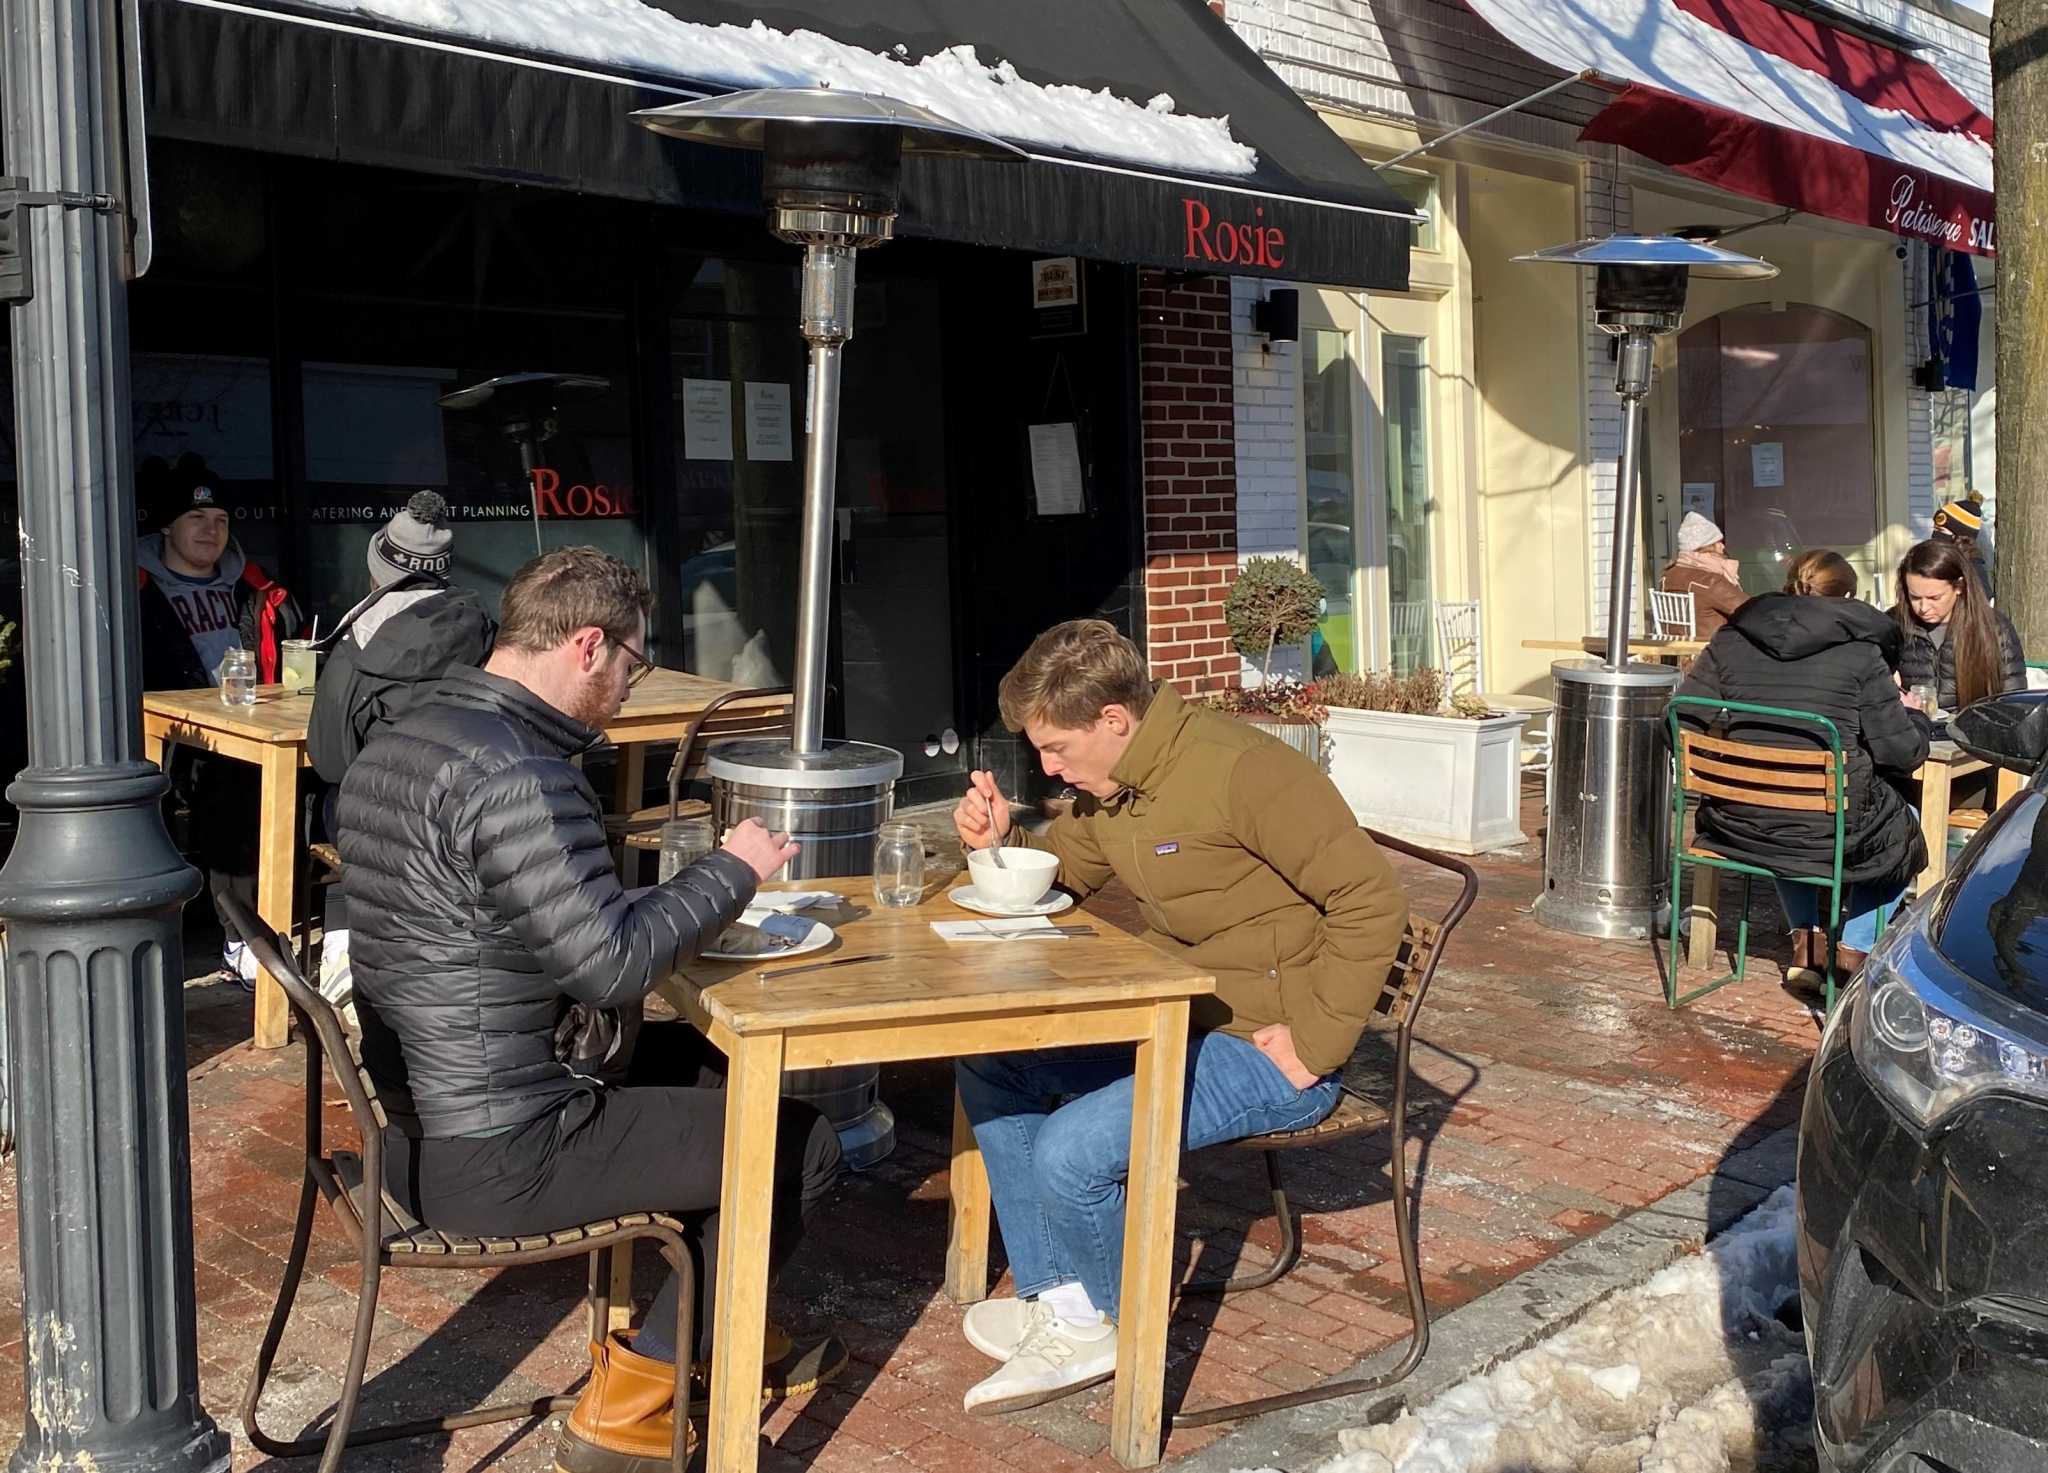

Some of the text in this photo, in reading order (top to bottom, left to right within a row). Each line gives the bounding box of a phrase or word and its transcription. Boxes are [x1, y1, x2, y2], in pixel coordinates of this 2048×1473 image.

[1181, 198, 1286, 269] Rosie
[306, 506, 374, 520] ATERING
[463, 504, 530, 518] PLANNING
